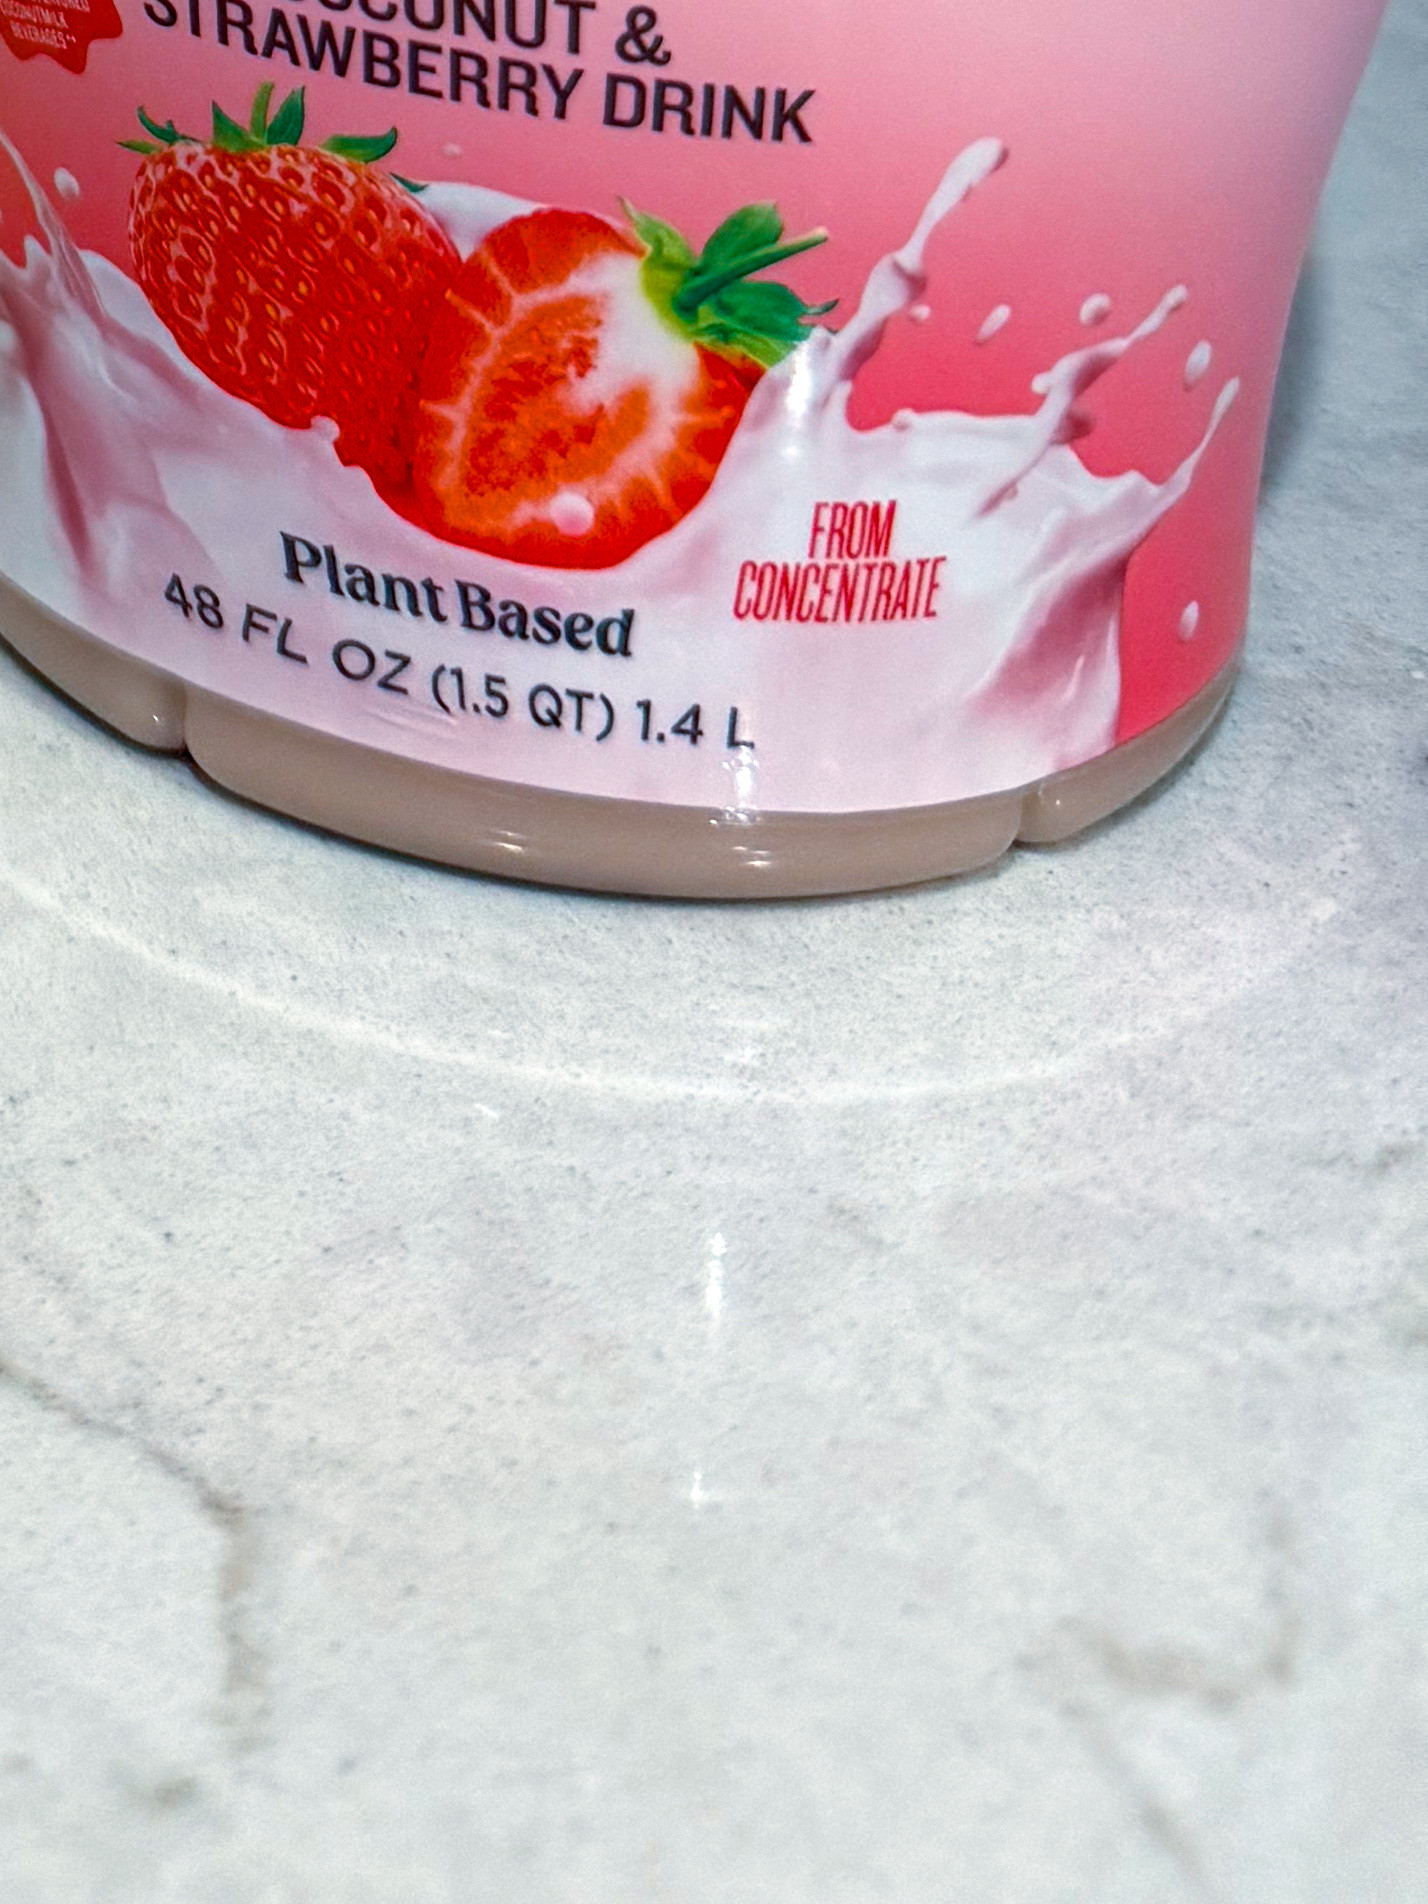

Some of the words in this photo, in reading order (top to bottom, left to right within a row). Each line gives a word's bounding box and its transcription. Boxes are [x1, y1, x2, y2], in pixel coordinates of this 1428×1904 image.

[614, 4, 672, 67] &
[602, 72, 817, 144] DRINK
[808, 500, 898, 560] FROM
[278, 531, 449, 624] Plant
[455, 578, 635, 658] Based
[734, 553, 948, 623] CONCENTRATE
[163, 573, 225, 629] 48
[240, 604, 310, 665] FL
[331, 637, 413, 695] OZ
[432, 664, 509, 719] (1.5
[527, 683, 616, 743] QT)
[636, 698, 705, 746] 1.4
[726, 707, 755, 750] L
